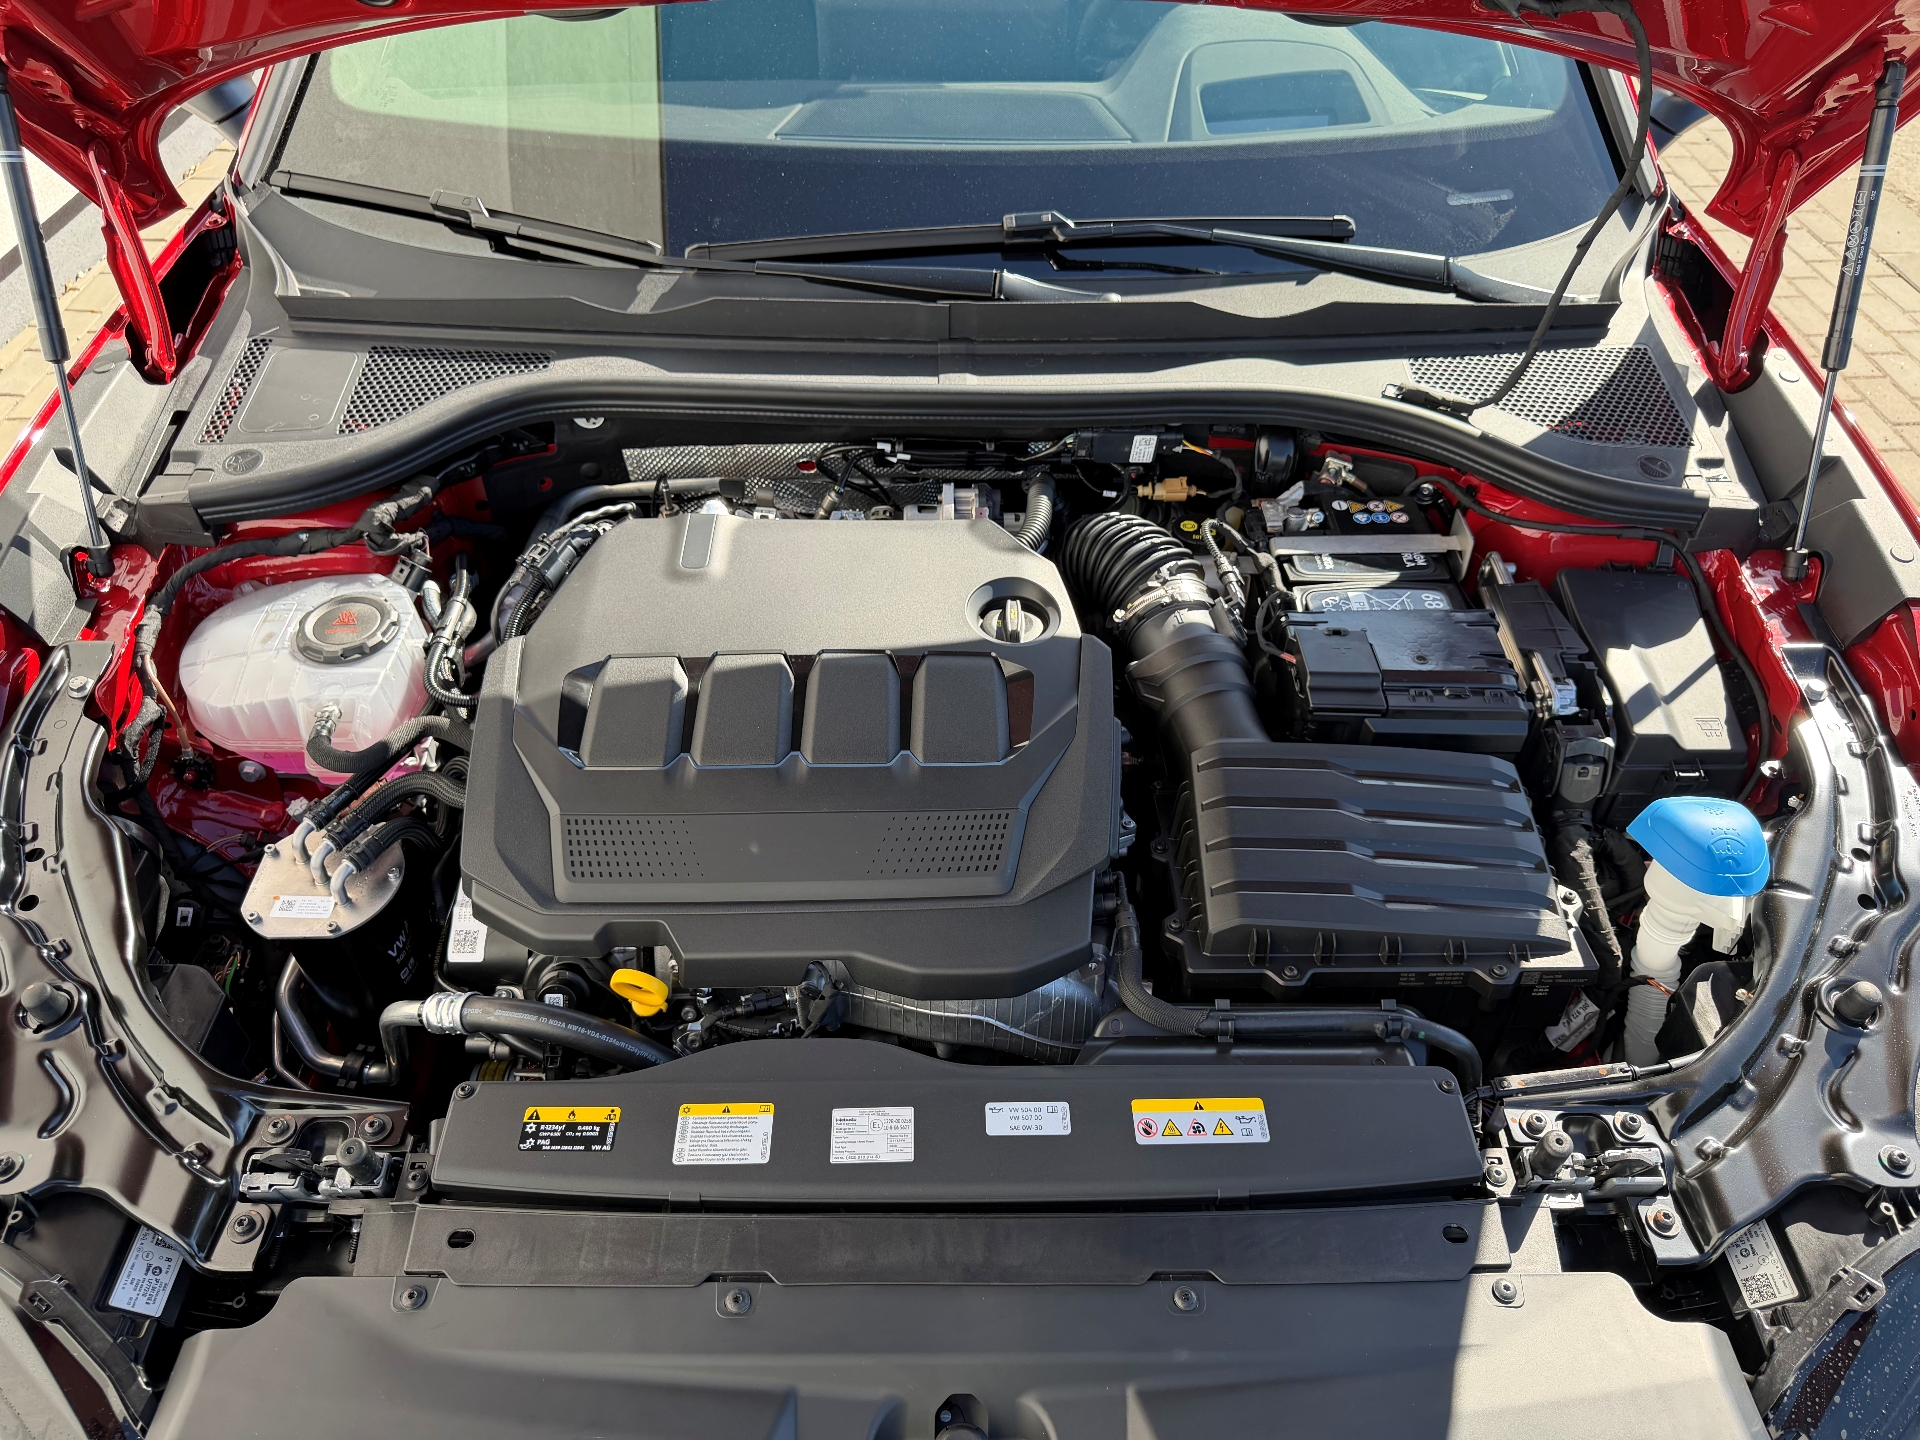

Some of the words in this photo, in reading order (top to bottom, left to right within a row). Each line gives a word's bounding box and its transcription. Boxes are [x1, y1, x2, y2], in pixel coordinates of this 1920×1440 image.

[1421, 593, 1444, 609] 68
[388, 930, 406, 957] VW
[540, 1124, 566, 1132] R-1234yf
